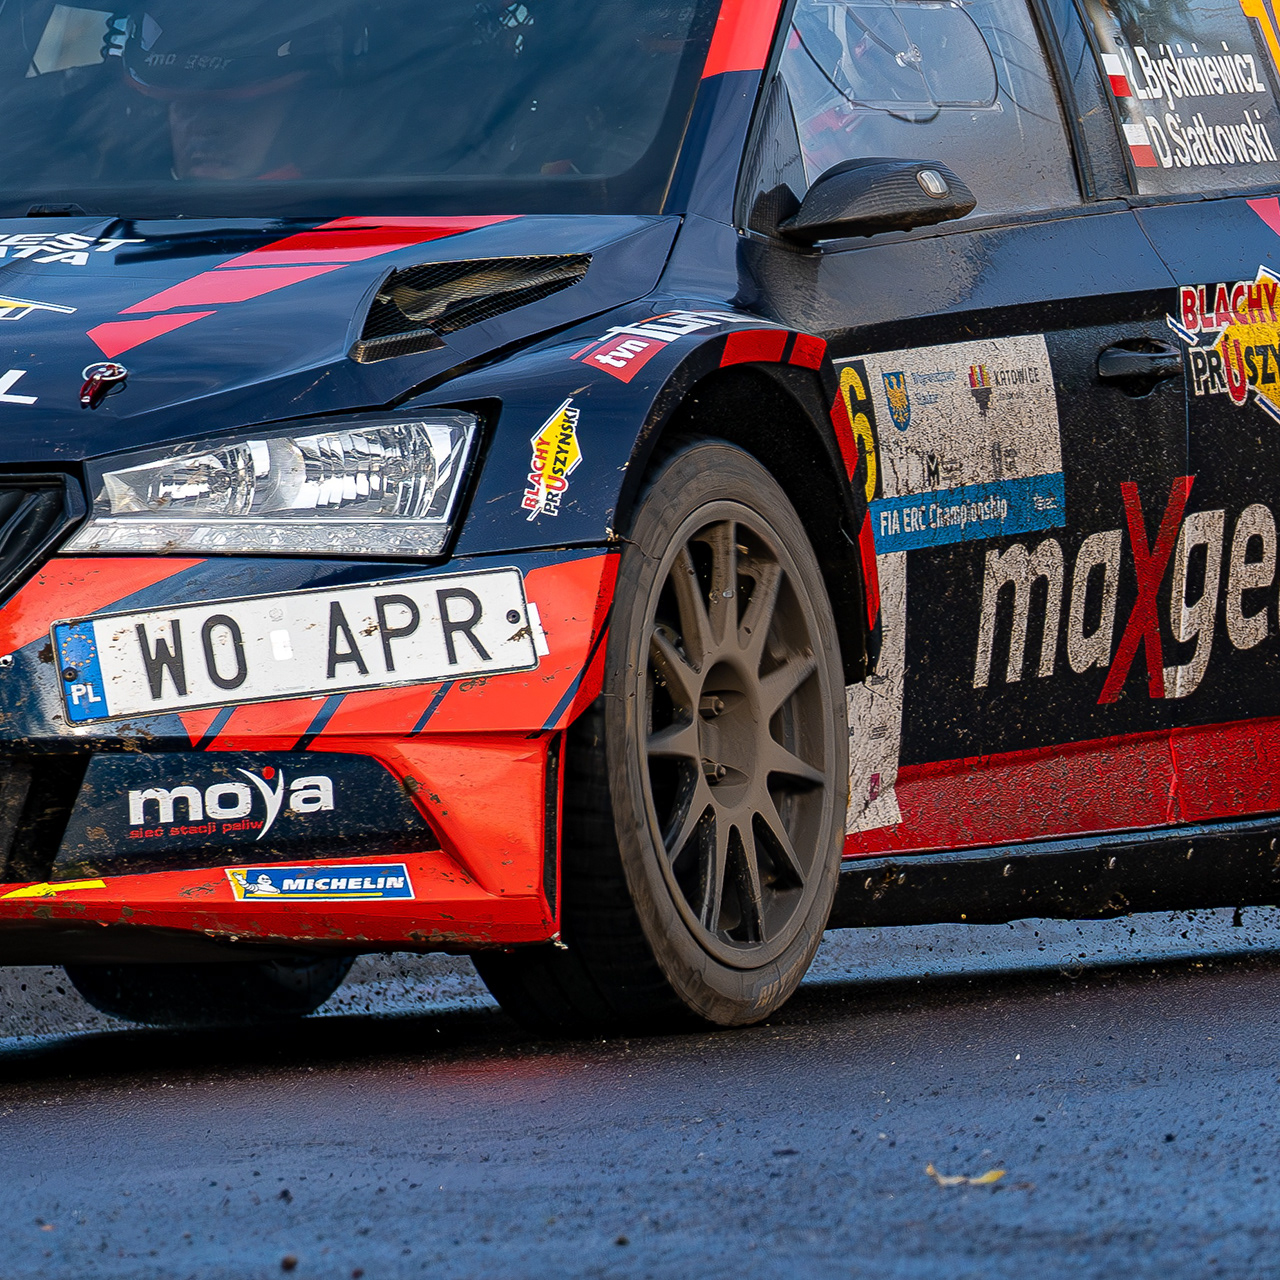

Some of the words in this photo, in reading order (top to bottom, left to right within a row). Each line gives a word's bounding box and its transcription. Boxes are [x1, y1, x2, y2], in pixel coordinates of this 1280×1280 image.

[1146, 109, 1278, 168] D.Siatkowski
[1180, 281, 1279, 330] BLACHY
[594, 338, 651, 368] tvn
[994, 366, 1040, 387] KATOWICE
[523, 435, 551, 509] BLACHY
[543, 406, 579, 516] PRUSZYŃSKI
[880, 510, 900, 536] FIA
[903, 505, 926, 533] ERC
[929, 495, 1008, 530] Championship
[135, 613, 250, 700] WO
[325, 586, 492, 680] APR
[69, 681, 102, 706] PL
[128, 767, 335, 841] moya
[129, 826, 165, 840] sieć
[169, 822, 217, 837] stacji
[222, 819, 264, 834] paliw
[281, 874, 405, 892] MICHELIN
